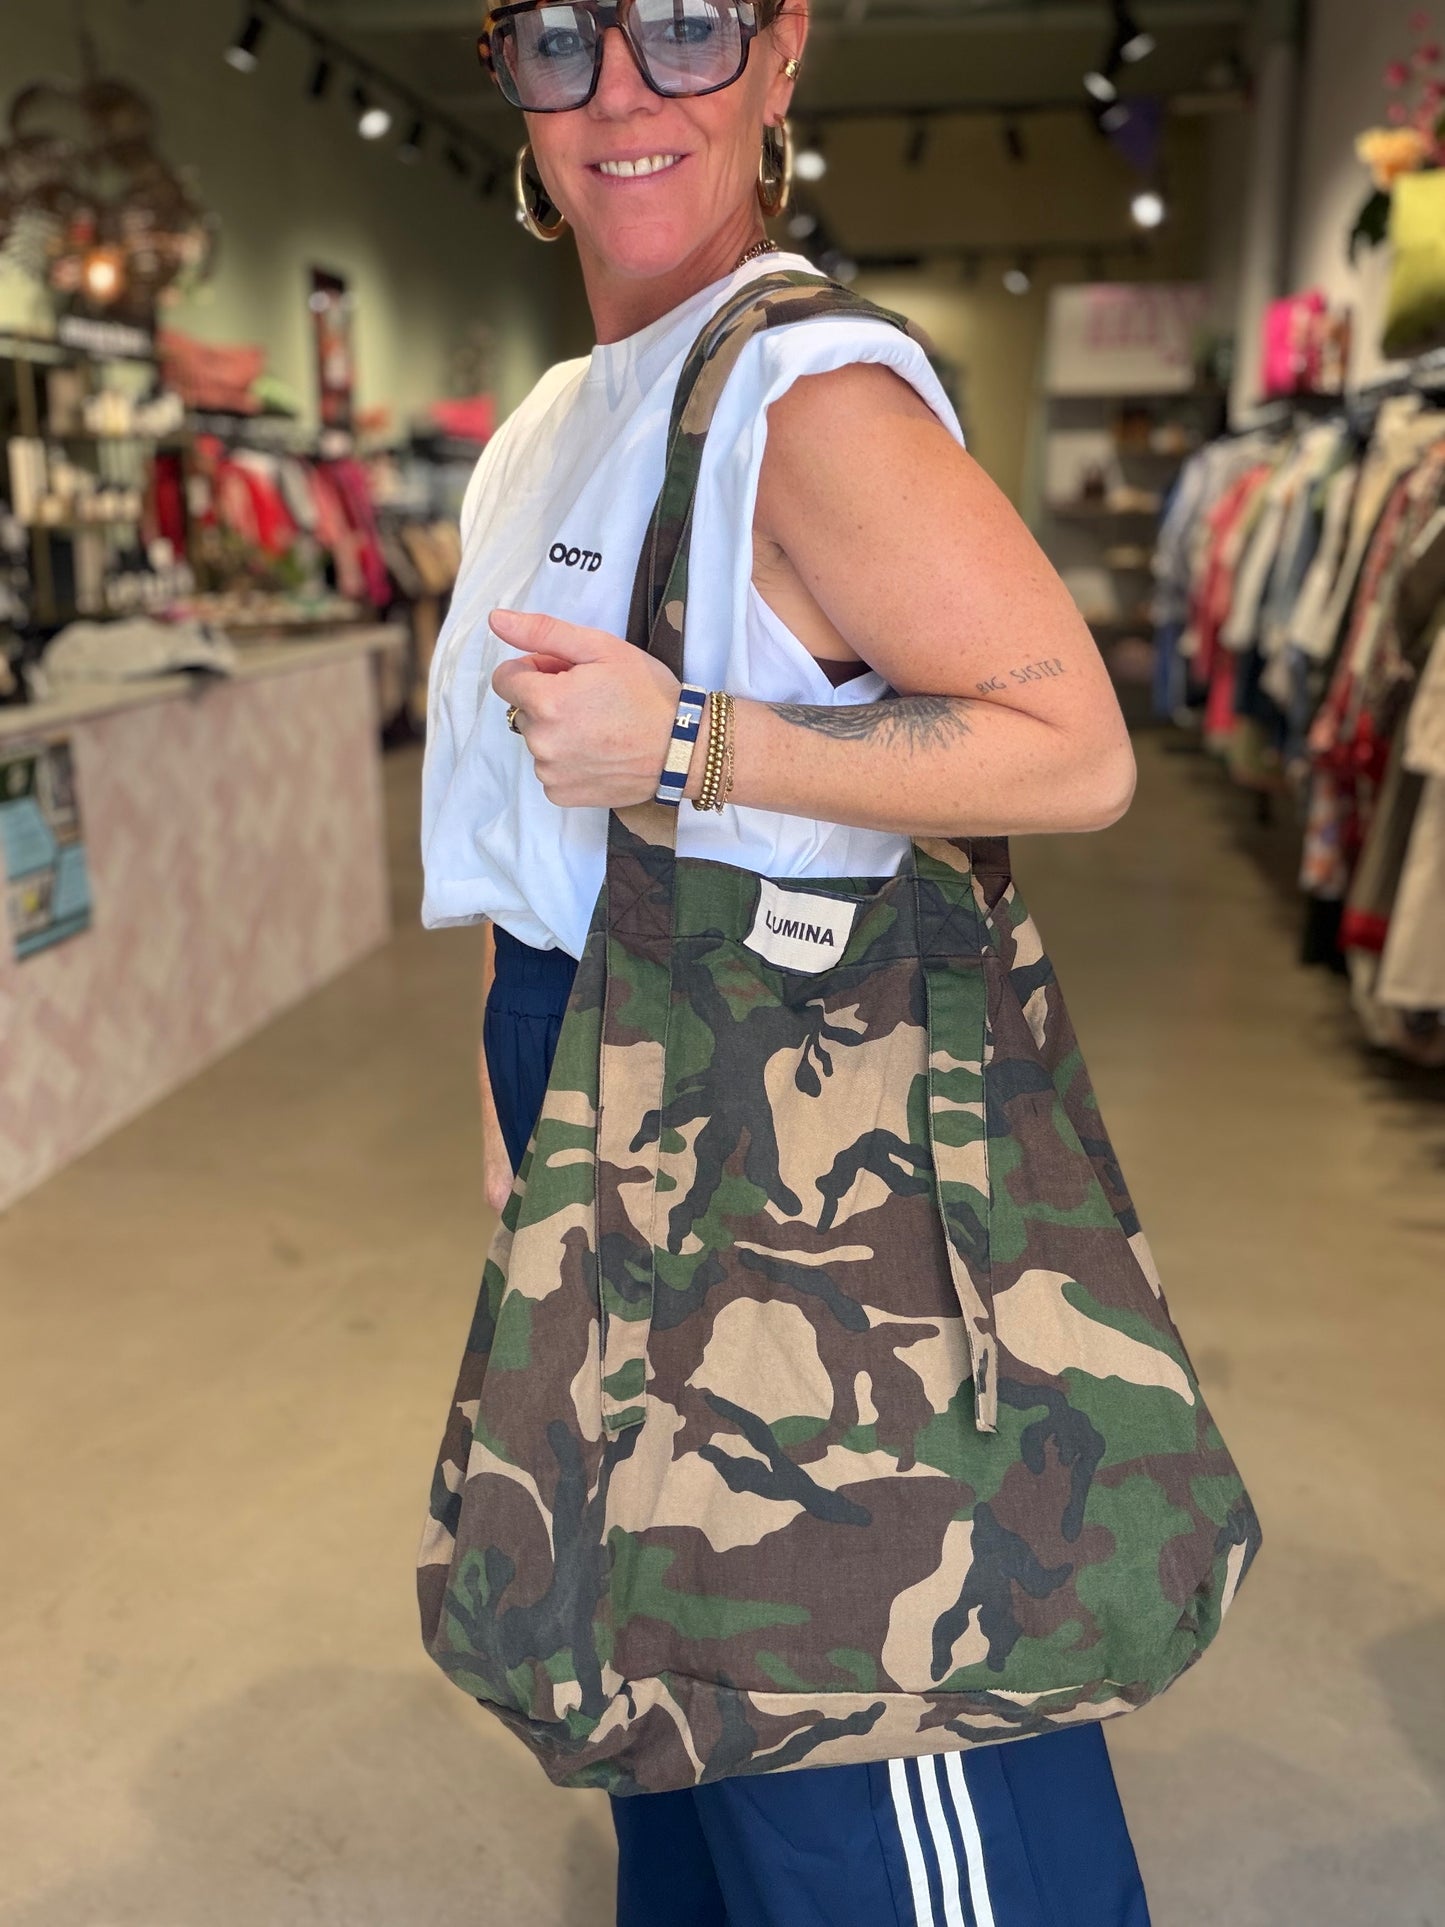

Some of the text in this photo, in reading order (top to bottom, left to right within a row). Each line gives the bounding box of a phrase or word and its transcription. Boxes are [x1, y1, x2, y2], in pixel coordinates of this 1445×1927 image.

[549, 543, 602, 572] OOTD
[976, 658, 1065, 695] BIG SISTER
[766, 910, 834, 947] LUMINA
